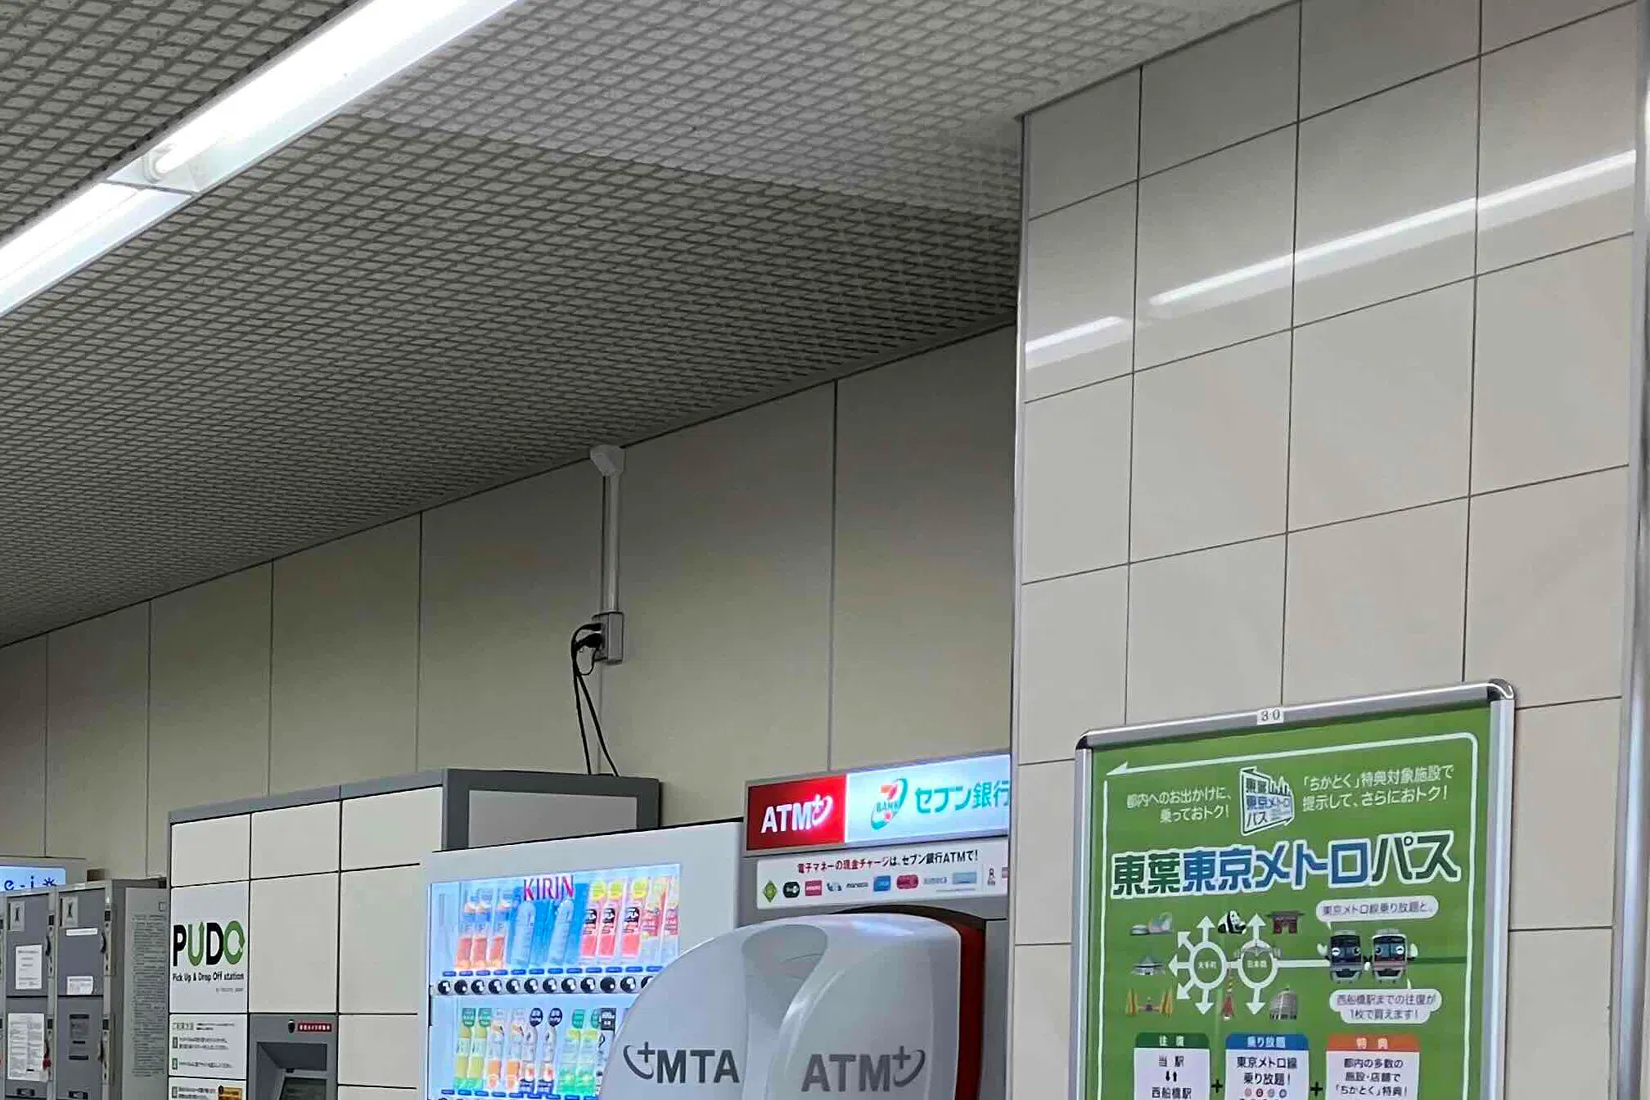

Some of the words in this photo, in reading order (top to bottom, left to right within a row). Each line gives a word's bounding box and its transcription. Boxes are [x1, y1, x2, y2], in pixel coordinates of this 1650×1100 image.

[1262, 708, 1281, 721] 30
[915, 780, 1010, 814] セブン銀行
[1302, 786, 1448, 812] 提示して、さらにおトク！
[761, 803, 813, 833] ATM
[1160, 806, 1230, 824] 乗っておトク！
[1113, 834, 1459, 896] 東葉東京メトロパス
[523, 875, 574, 901] KIRIN
[173, 920, 245, 967] PUDO
[801, 1052, 894, 1093] ATM
